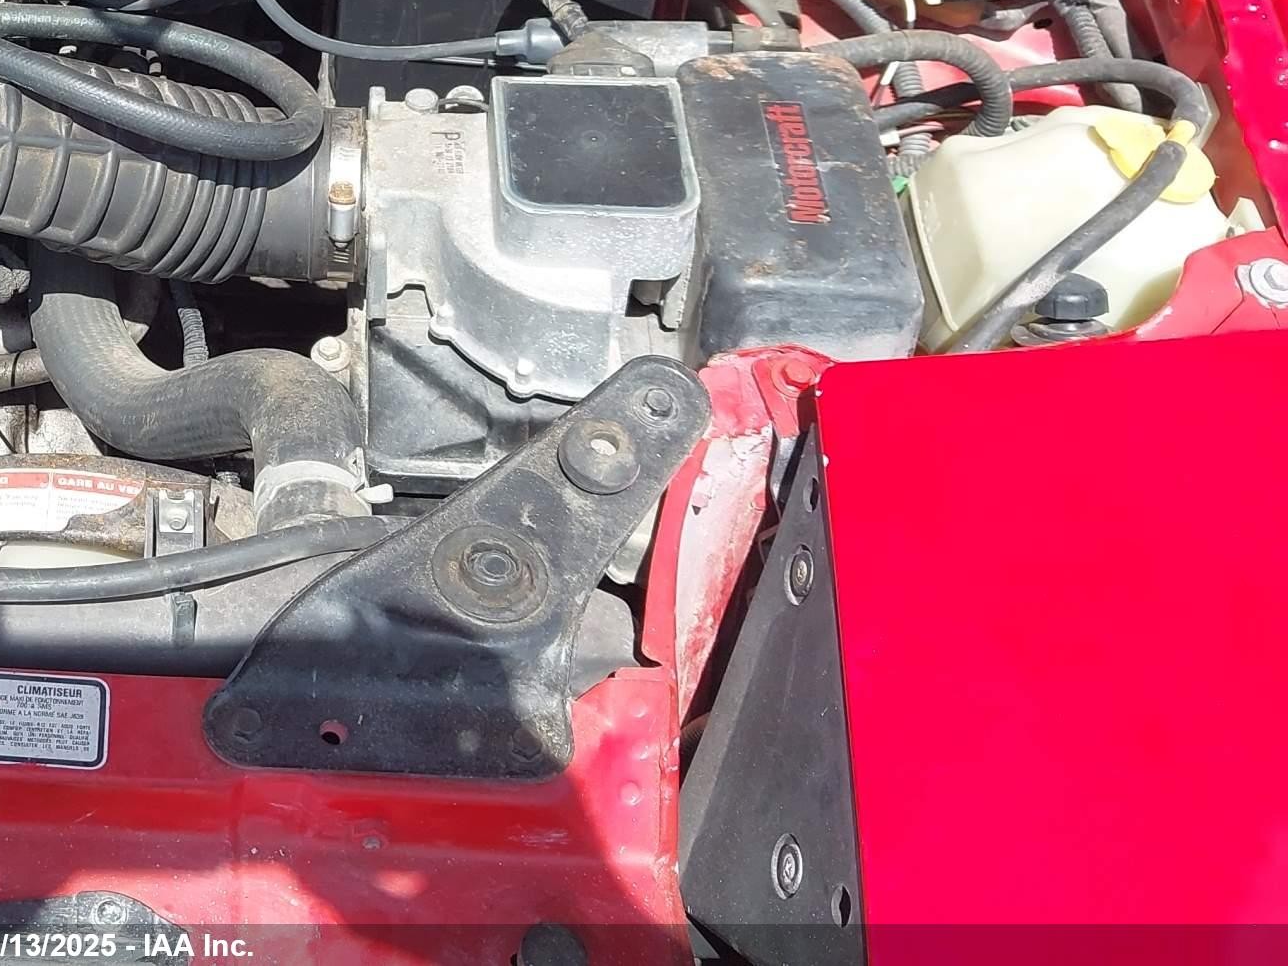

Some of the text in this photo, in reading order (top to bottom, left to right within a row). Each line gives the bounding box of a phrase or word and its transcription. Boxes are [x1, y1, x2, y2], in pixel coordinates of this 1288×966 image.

[763, 104, 827, 223] Motorcraft
[57, 478, 94, 490] GARE
[96, 481, 116, 491] AU
[17, 685, 82, 698] CLIMATISEUR
